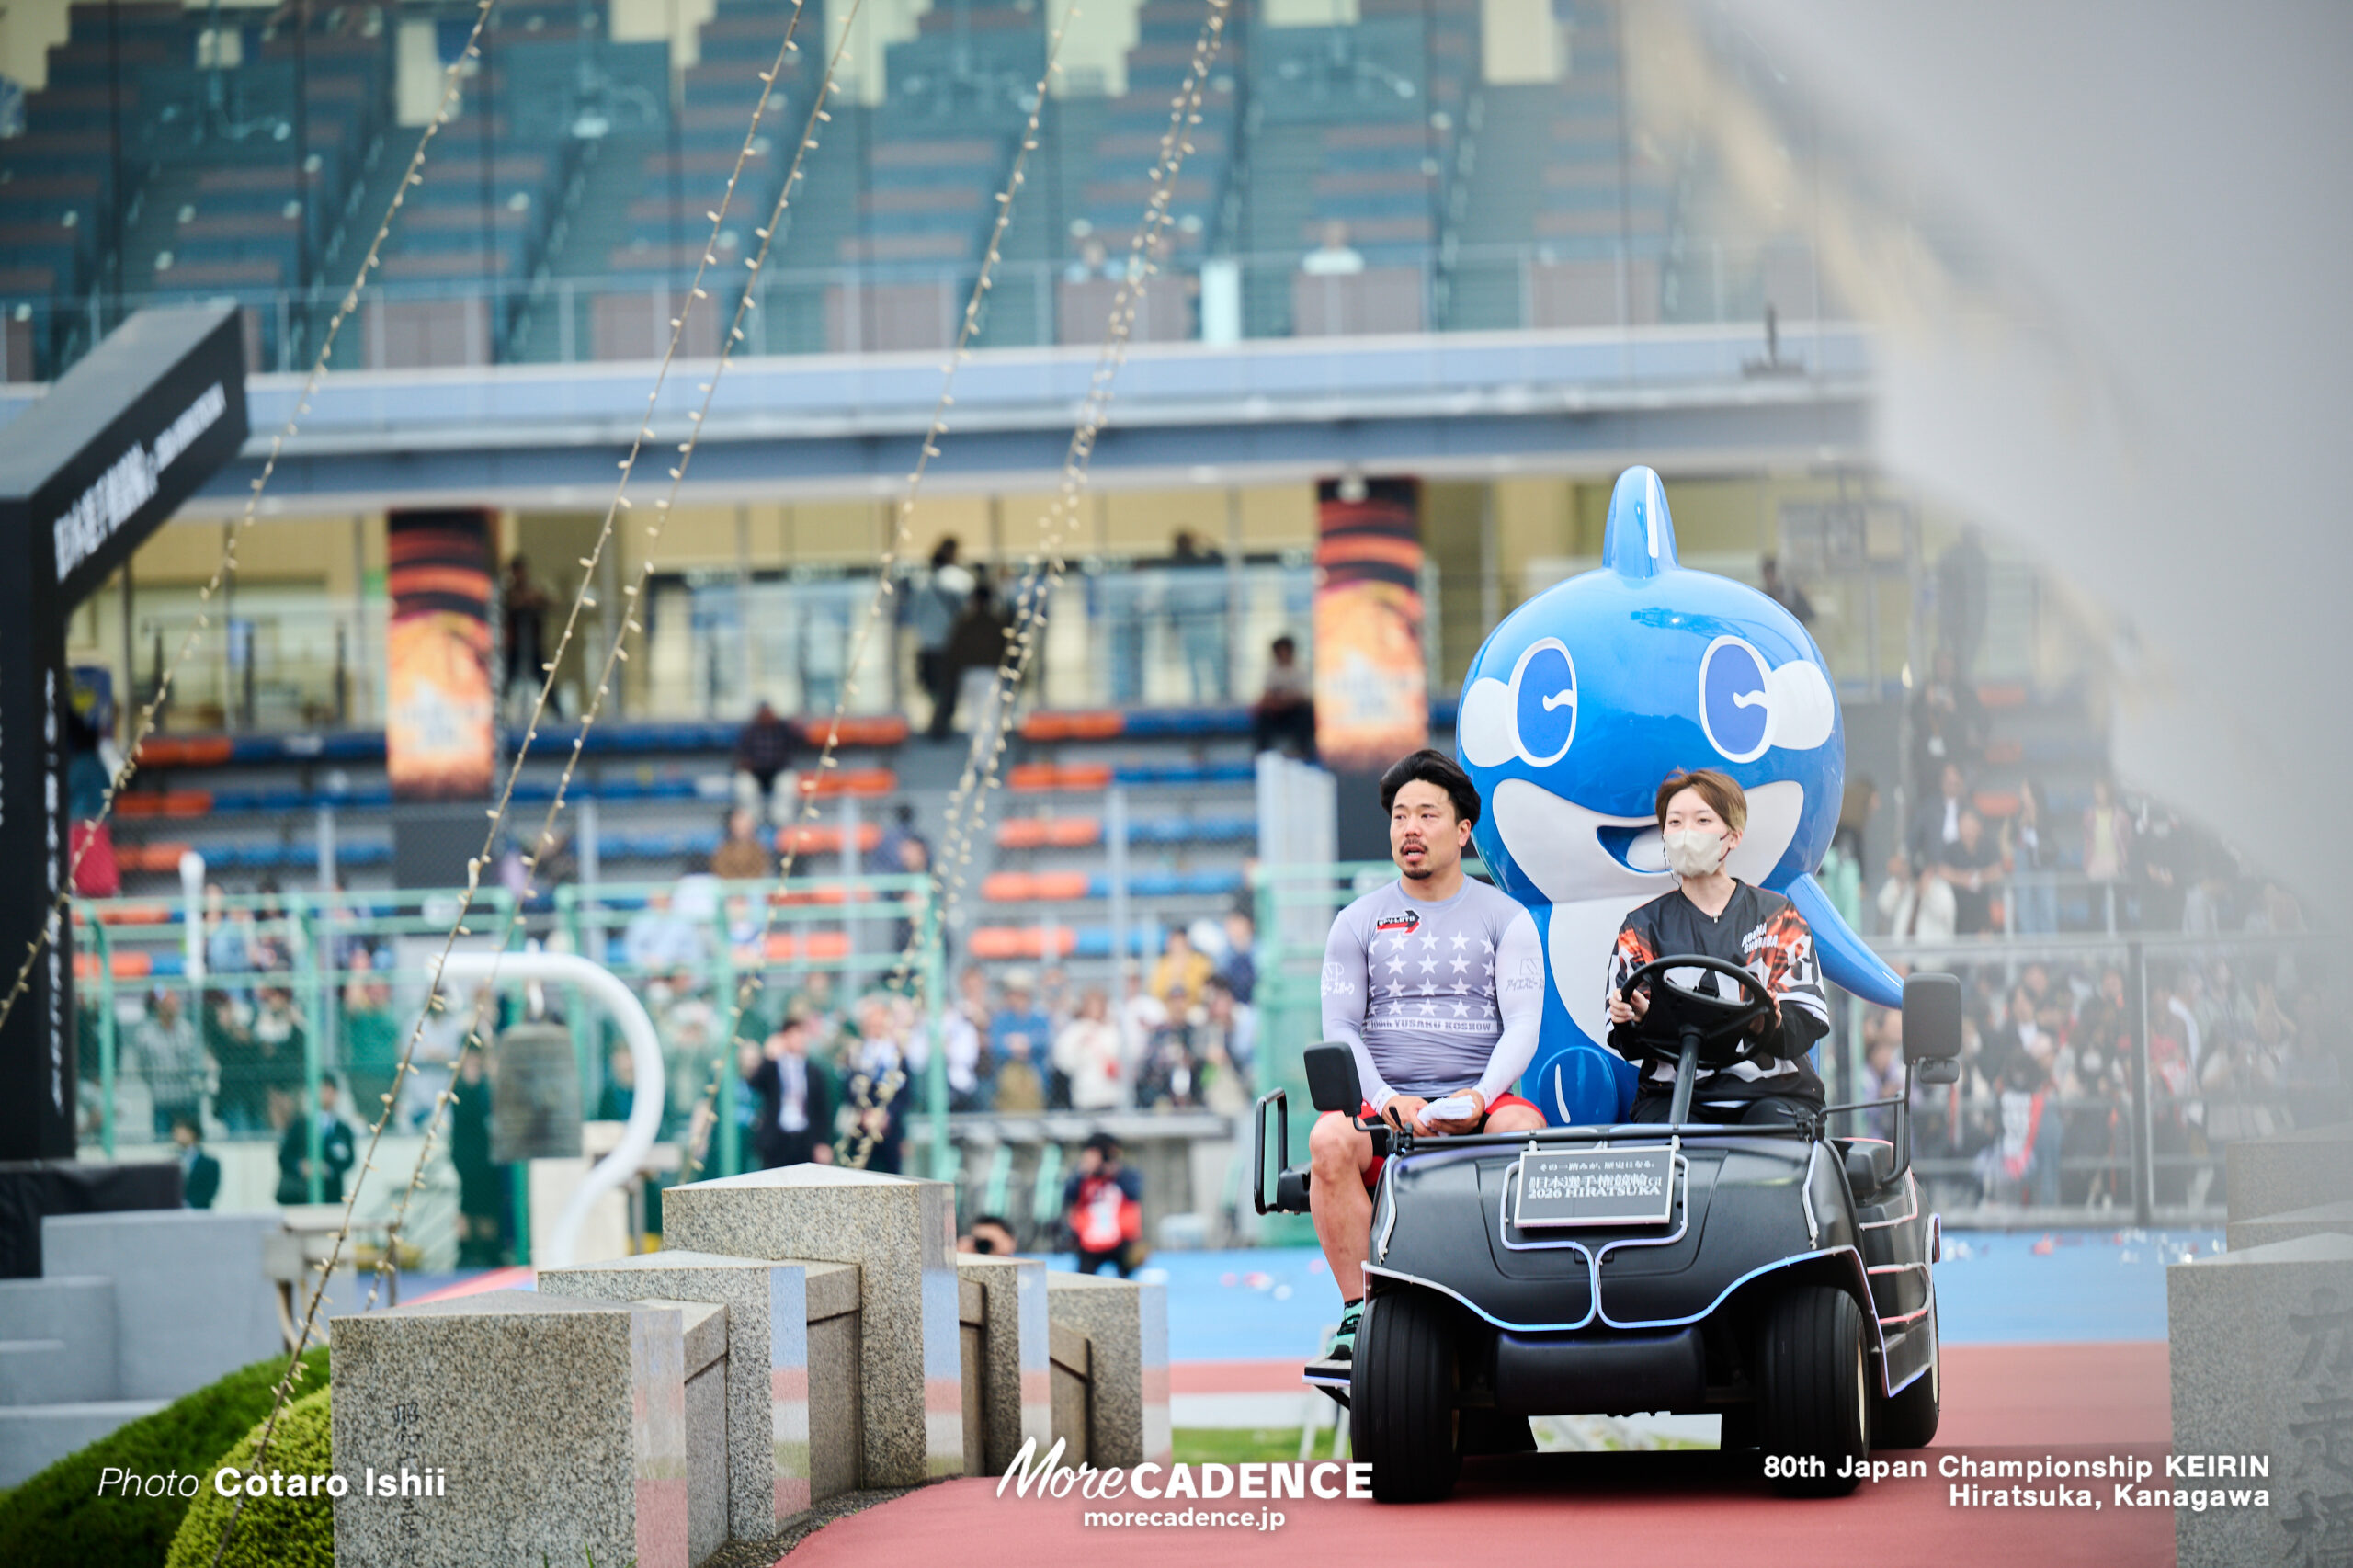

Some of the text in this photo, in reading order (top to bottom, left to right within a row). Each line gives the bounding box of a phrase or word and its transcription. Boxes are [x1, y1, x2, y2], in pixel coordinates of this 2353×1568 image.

[1394, 1018, 1441, 1029] YUSAKU
[1528, 1183, 1661, 1199] 2026 HIRATSUKA
